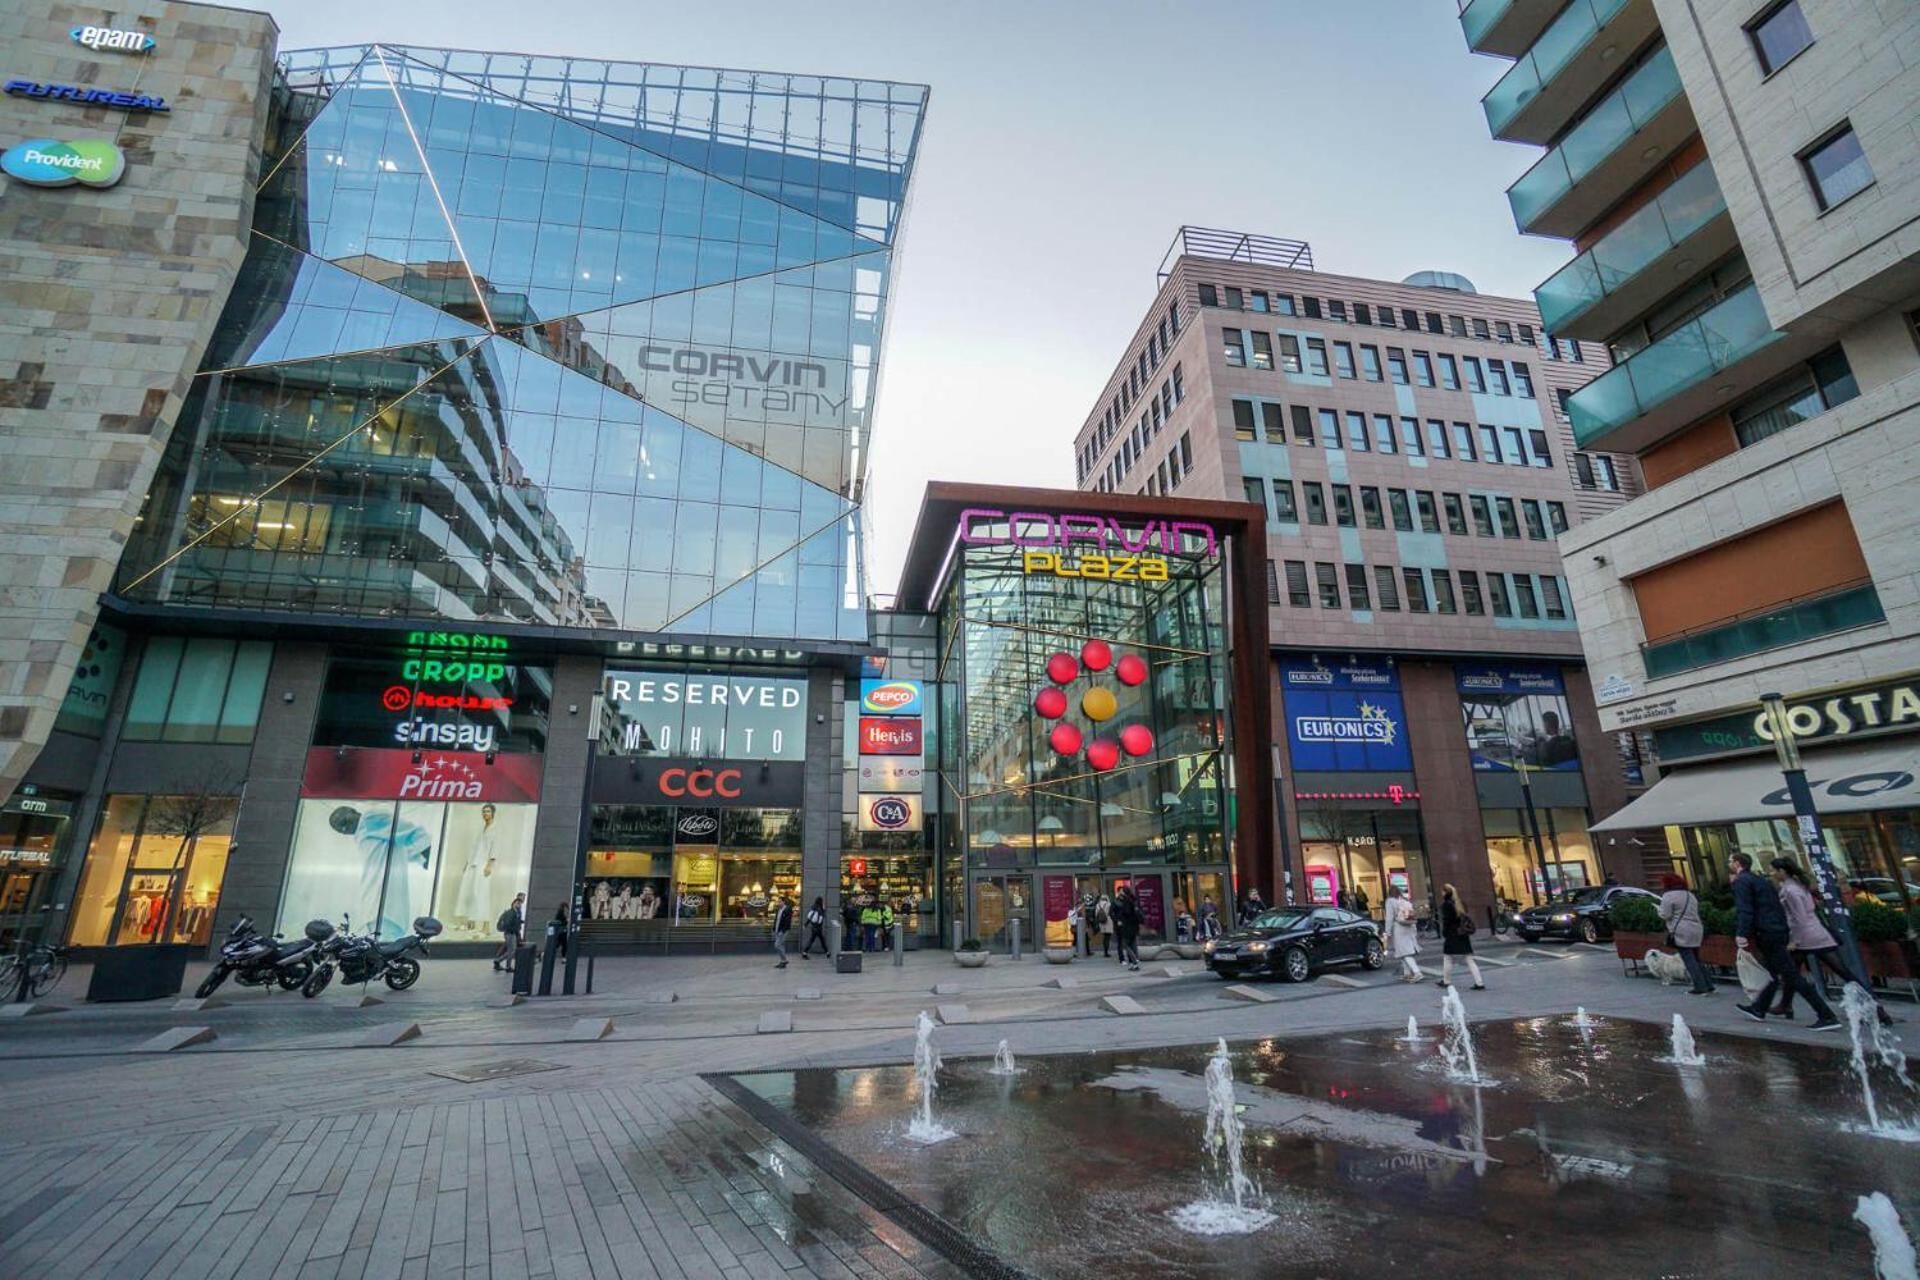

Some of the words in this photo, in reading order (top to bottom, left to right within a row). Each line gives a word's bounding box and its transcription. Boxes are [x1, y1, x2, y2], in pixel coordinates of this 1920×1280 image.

[81, 26, 144, 50] epam
[3, 80, 170, 112] FUTUREAL
[25, 149, 103, 171] Provident
[402, 659, 504, 683] CROPP
[415, 691, 512, 710] house
[612, 680, 800, 708] RESERVED
[872, 691, 910, 702] PEPCO
[1754, 687, 1920, 741] COSTA
[395, 716, 493, 752] sinsay
[625, 723, 783, 754] MOHITO
[870, 727, 913, 745] Hervis
[1303, 721, 1384, 737] EURONICS
[658, 768, 743, 797] CCC
[21, 799, 47, 812] arm
[1389, 785, 1403, 804] T
[877, 804, 905, 821] C&A
